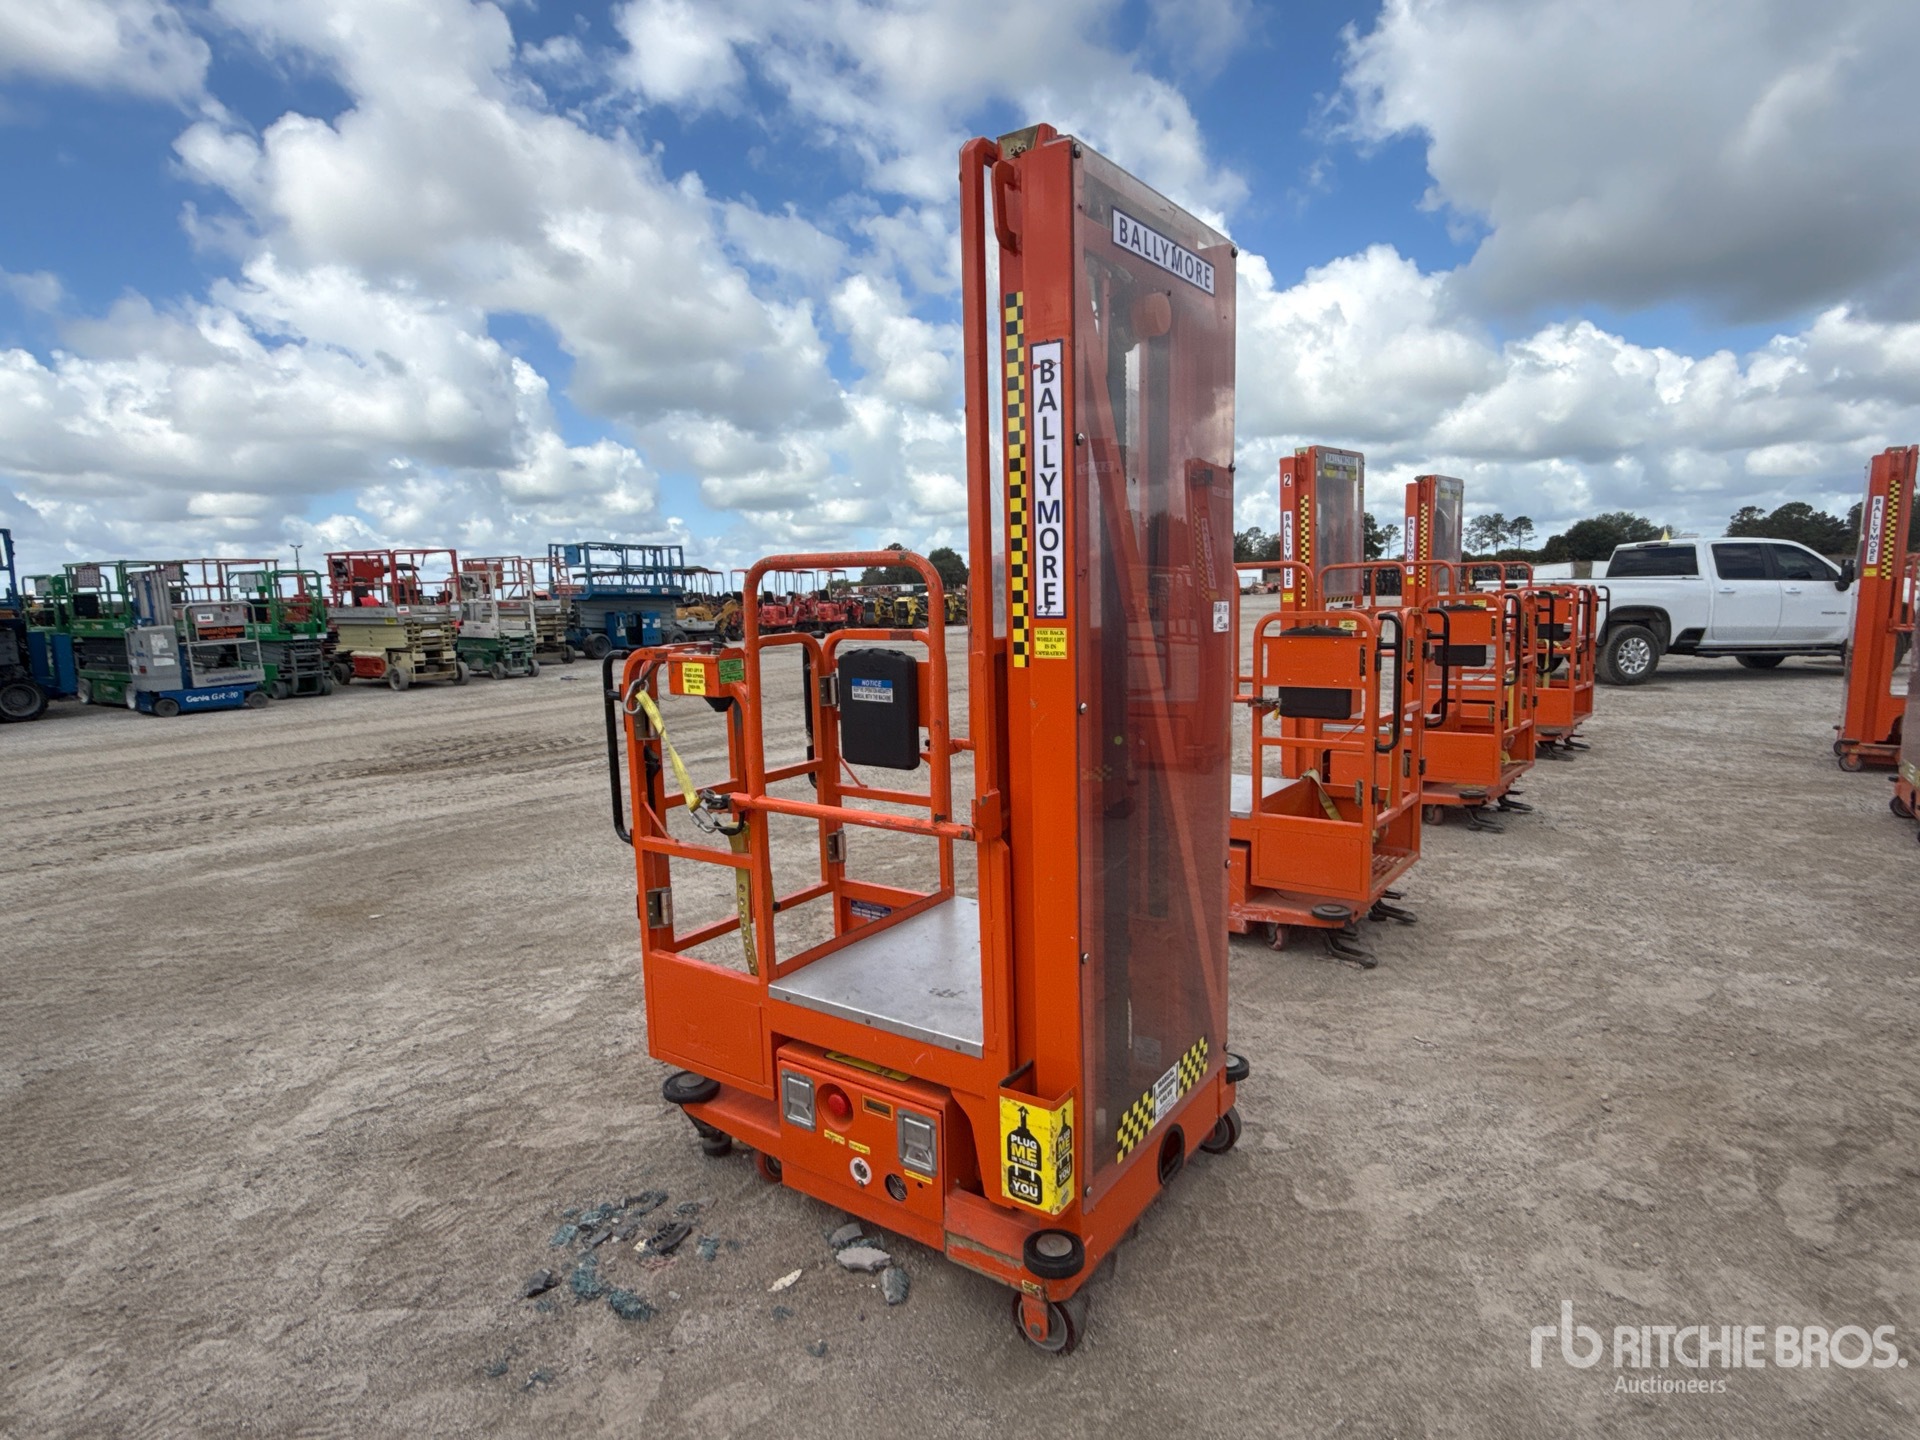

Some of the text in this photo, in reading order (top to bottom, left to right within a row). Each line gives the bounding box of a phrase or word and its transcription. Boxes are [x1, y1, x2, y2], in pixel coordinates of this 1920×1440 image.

[1119, 216, 1211, 289] BALLYMORE
[1037, 359, 1061, 606] BALLYMORE
[1284, 474, 1291, 486] 2
[1868, 498, 1881, 562] BALLYMORE
[1283, 514, 1292, 586] BALLYMRE
[1407, 519, 1415, 573] BALLYMOE
[186, 694, 210, 703] Genie
[1010, 1133, 1037, 1150] PLUG
[1058, 1136, 1071, 1156] ME
[1010, 1142, 1037, 1163] ME
[1018, 1158, 1037, 1169] TODAY
[1059, 1164, 1071, 1182] YOU
[1012, 1180, 1038, 1197] YOU
